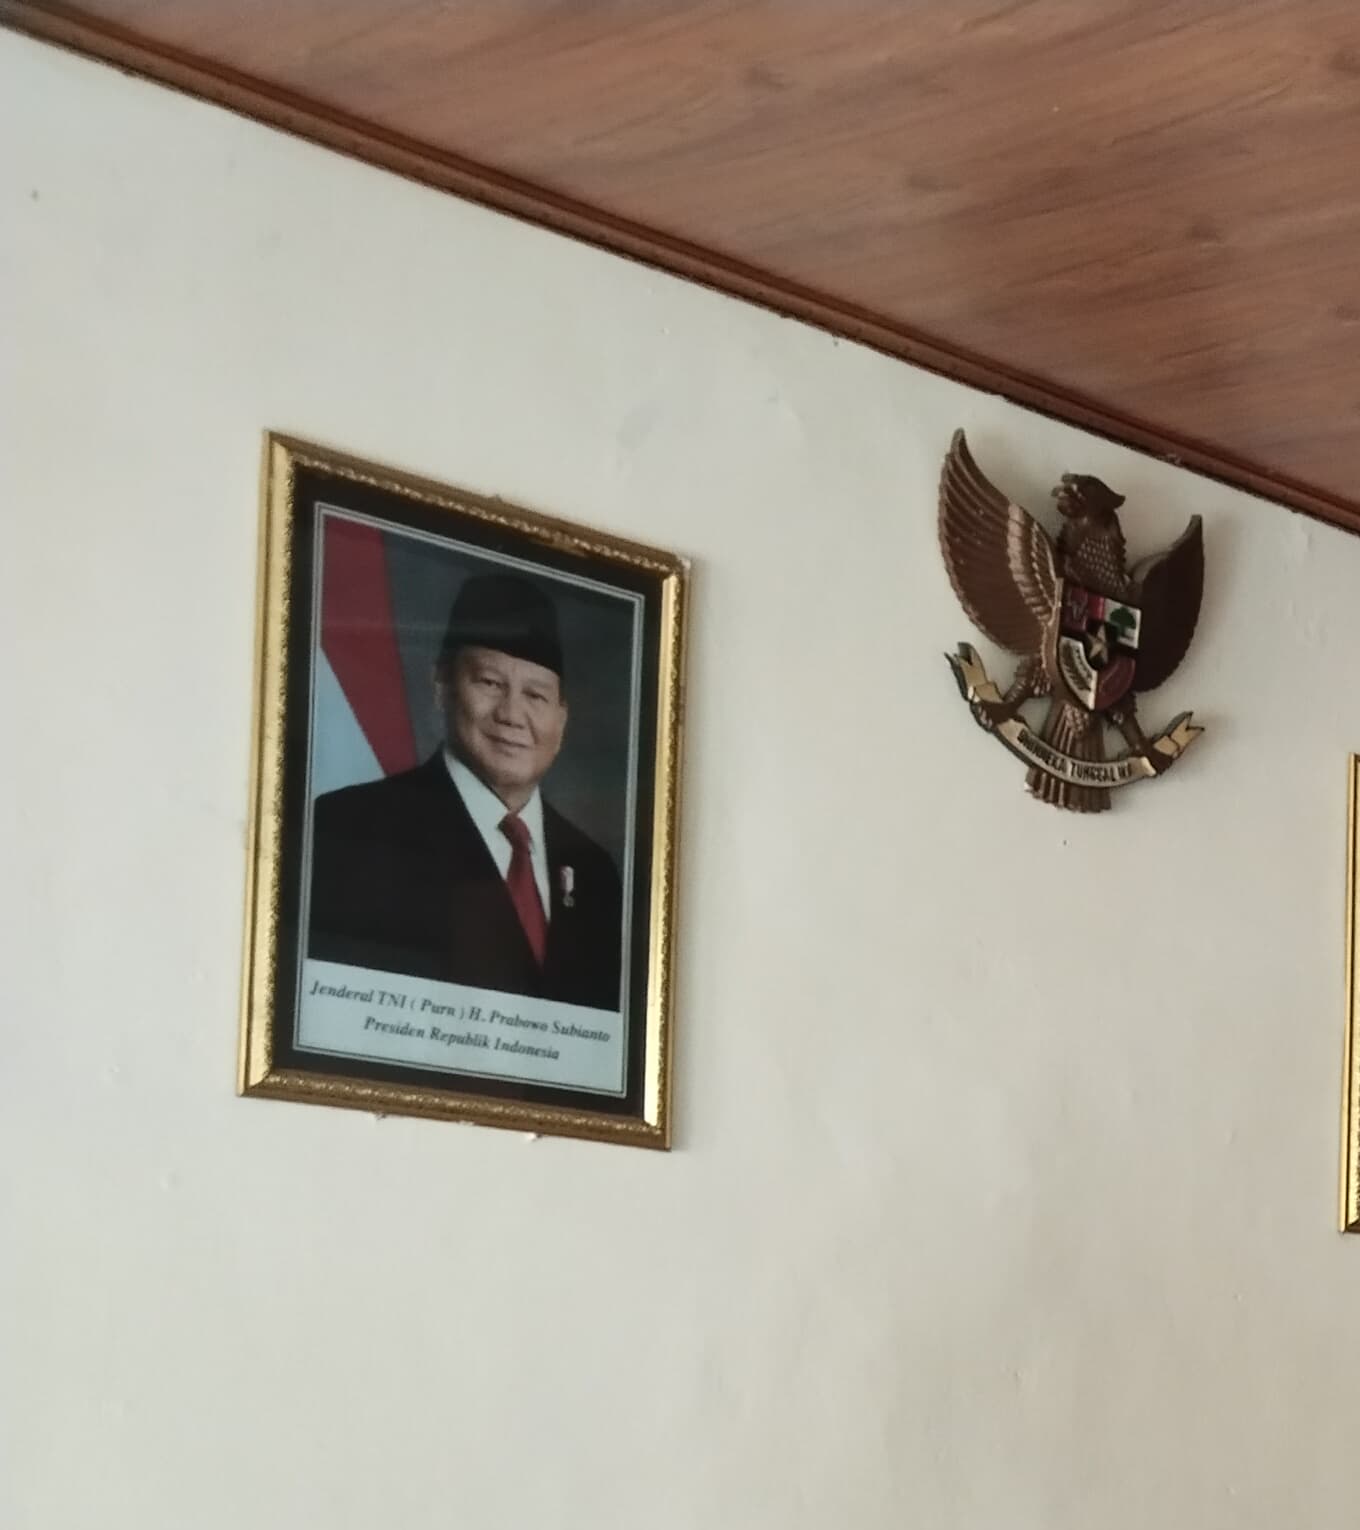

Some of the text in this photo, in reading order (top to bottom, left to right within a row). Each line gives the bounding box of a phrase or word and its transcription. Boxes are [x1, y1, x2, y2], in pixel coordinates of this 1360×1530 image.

[309, 980, 375, 1003] Jenderal
[377, 991, 406, 1009] TNI
[469, 1006, 487, 1022] H.
[489, 1010, 549, 1033] Prabowo
[552, 1021, 611, 1043] Subianto
[364, 1016, 560, 1061] Presiden Republik Indonesia
